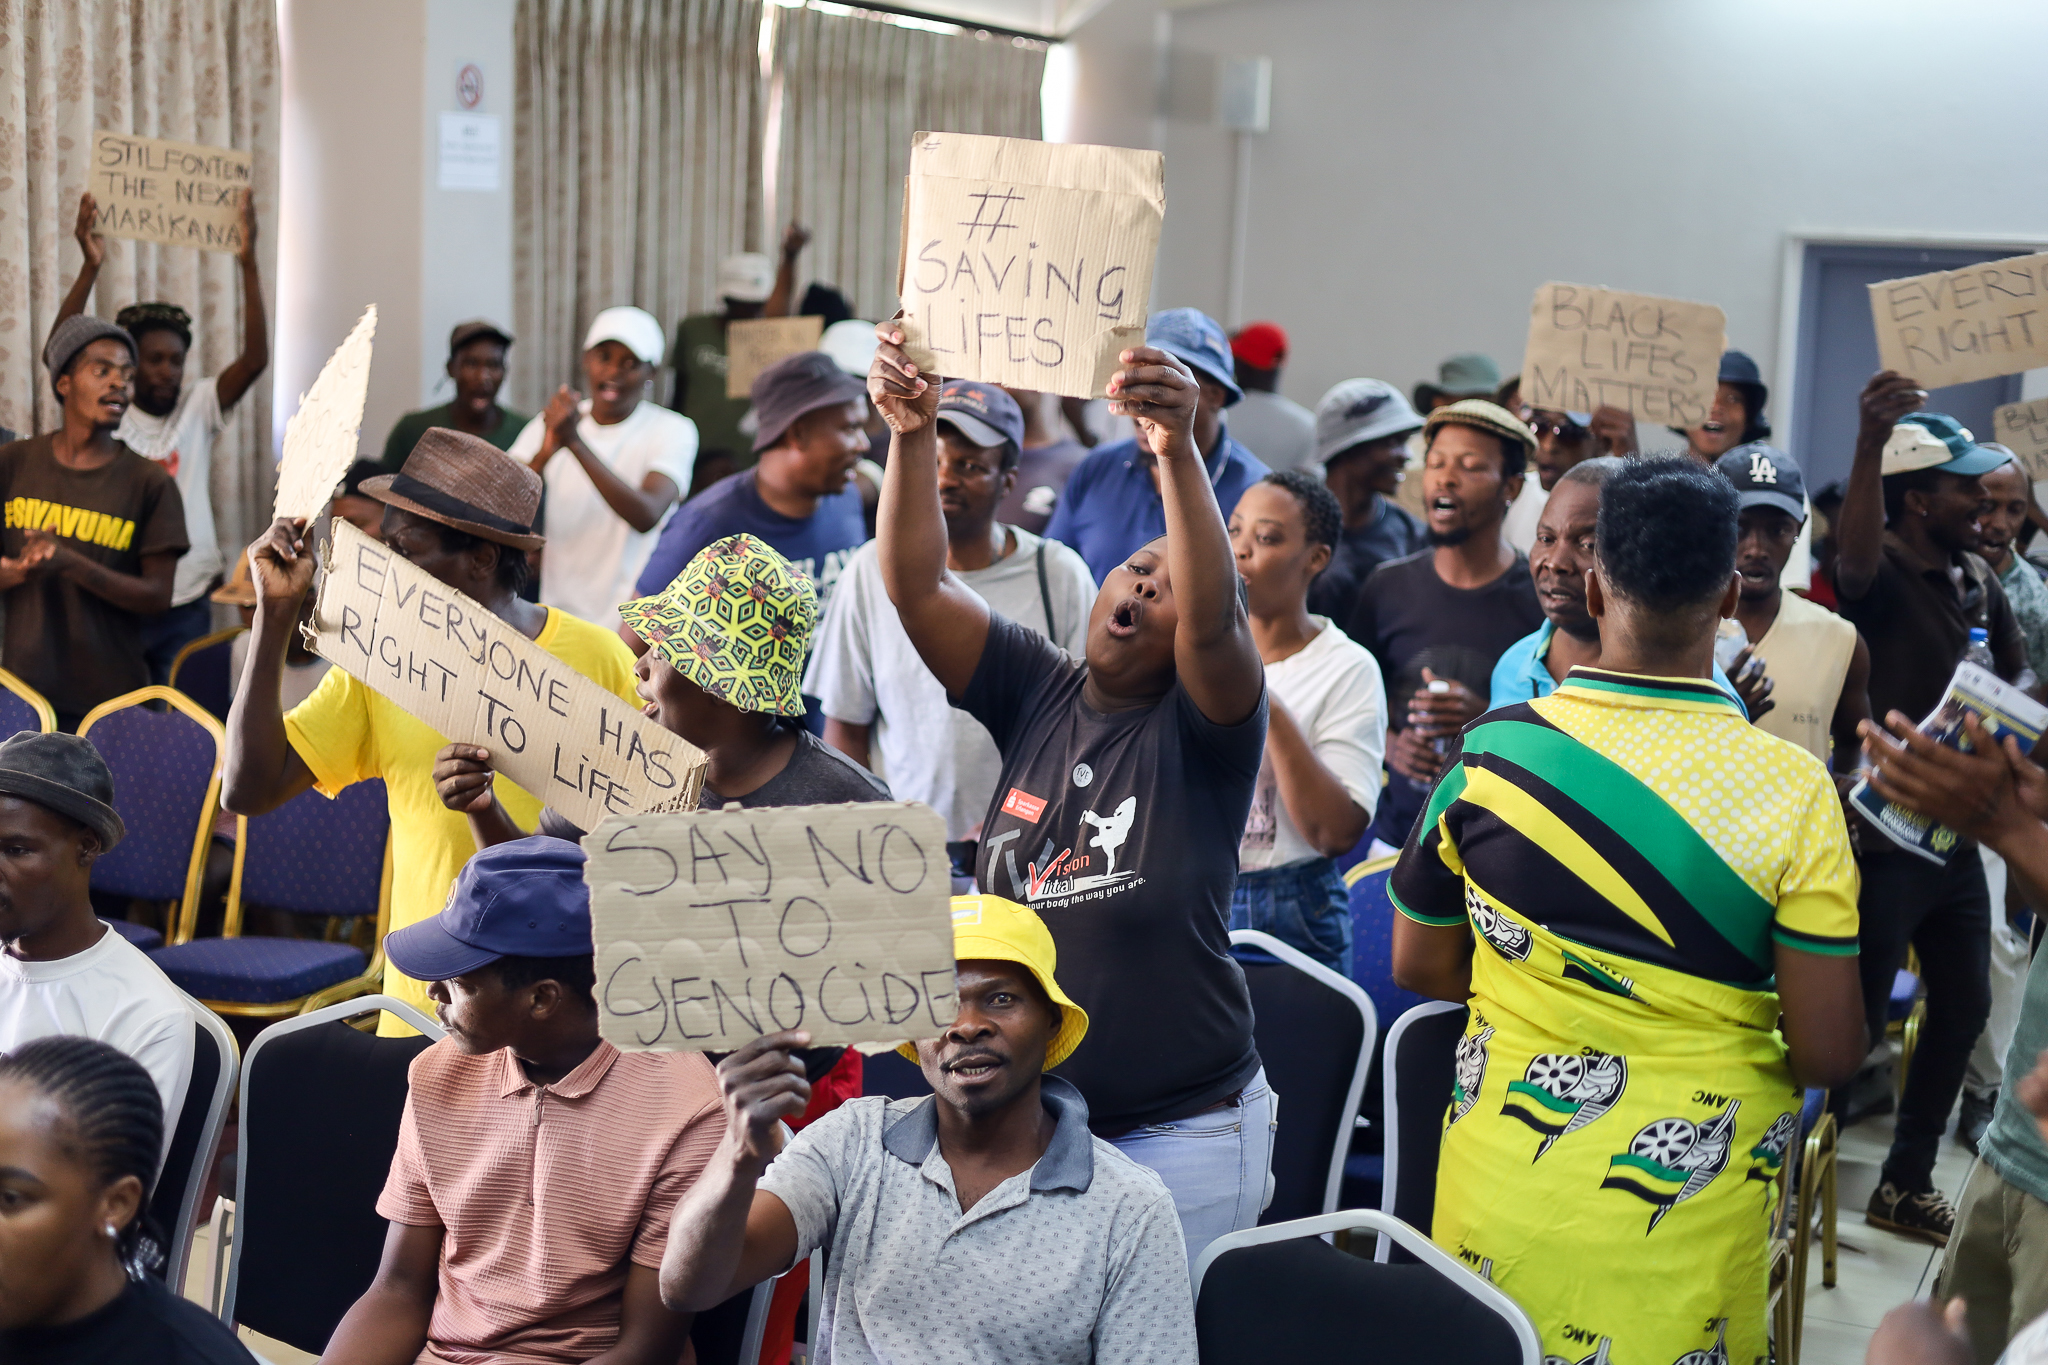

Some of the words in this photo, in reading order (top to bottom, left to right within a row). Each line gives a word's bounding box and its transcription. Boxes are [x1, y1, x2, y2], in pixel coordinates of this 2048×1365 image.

[99, 170, 157, 200] THE
[957, 185, 1026, 243] #
[1552, 285, 1684, 341] BLACK
[1579, 330, 1698, 386] LIFES
[1899, 309, 2038, 374] RIGHT
[1532, 363, 1707, 426] MATTERS
[1748, 452, 1778, 484] LA
[4, 496, 135, 551] #SIYAVUMA
[357, 543, 571, 718] EVERYONE
[599, 706, 677, 789] HAS
[477, 689, 527, 755] TO
[605, 823, 773, 897] SAY
[804, 823, 928, 894] NO
[1046, 898, 1070, 909] body
[1071, 895, 1085, 905] the
[1086, 889, 1105, 900] way
[1106, 884, 1126, 898] you
[1127, 876, 1147, 890] are.
[688, 896, 833, 968] TO
[1691, 1090, 1729, 1109] ANC
[1562, 1324, 1599, 1347] ANC
